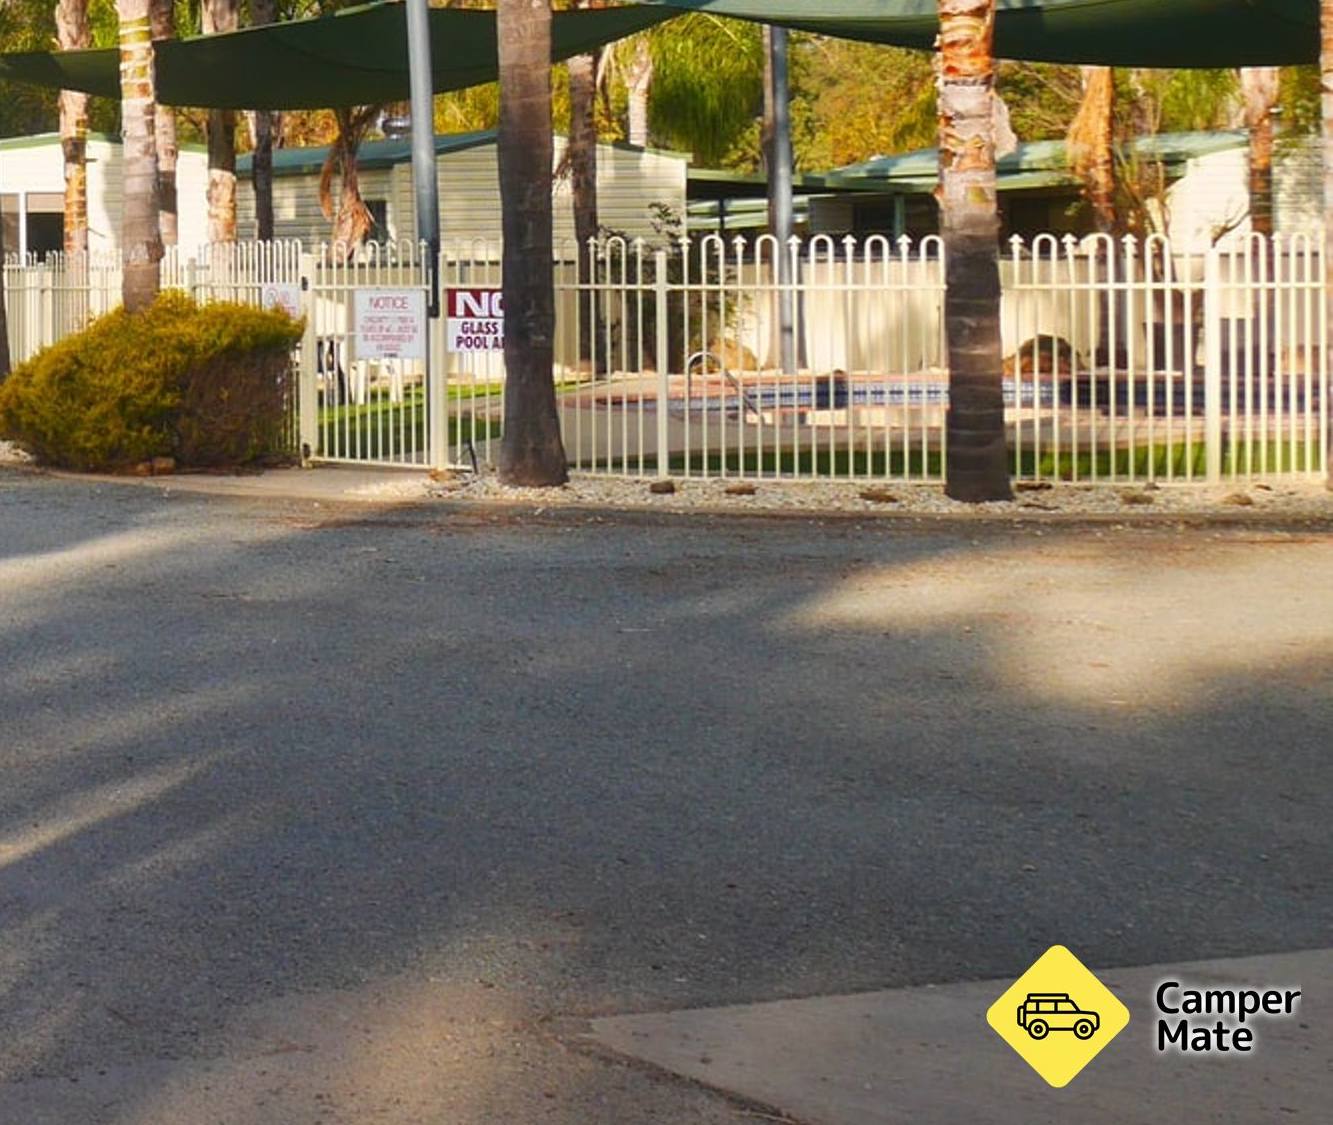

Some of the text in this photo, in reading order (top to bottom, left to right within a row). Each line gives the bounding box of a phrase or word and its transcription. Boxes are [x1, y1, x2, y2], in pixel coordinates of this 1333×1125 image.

[369, 296, 408, 309] NOTICE
[461, 321, 499, 335] GLASS
[456, 336, 488, 349] POOL
